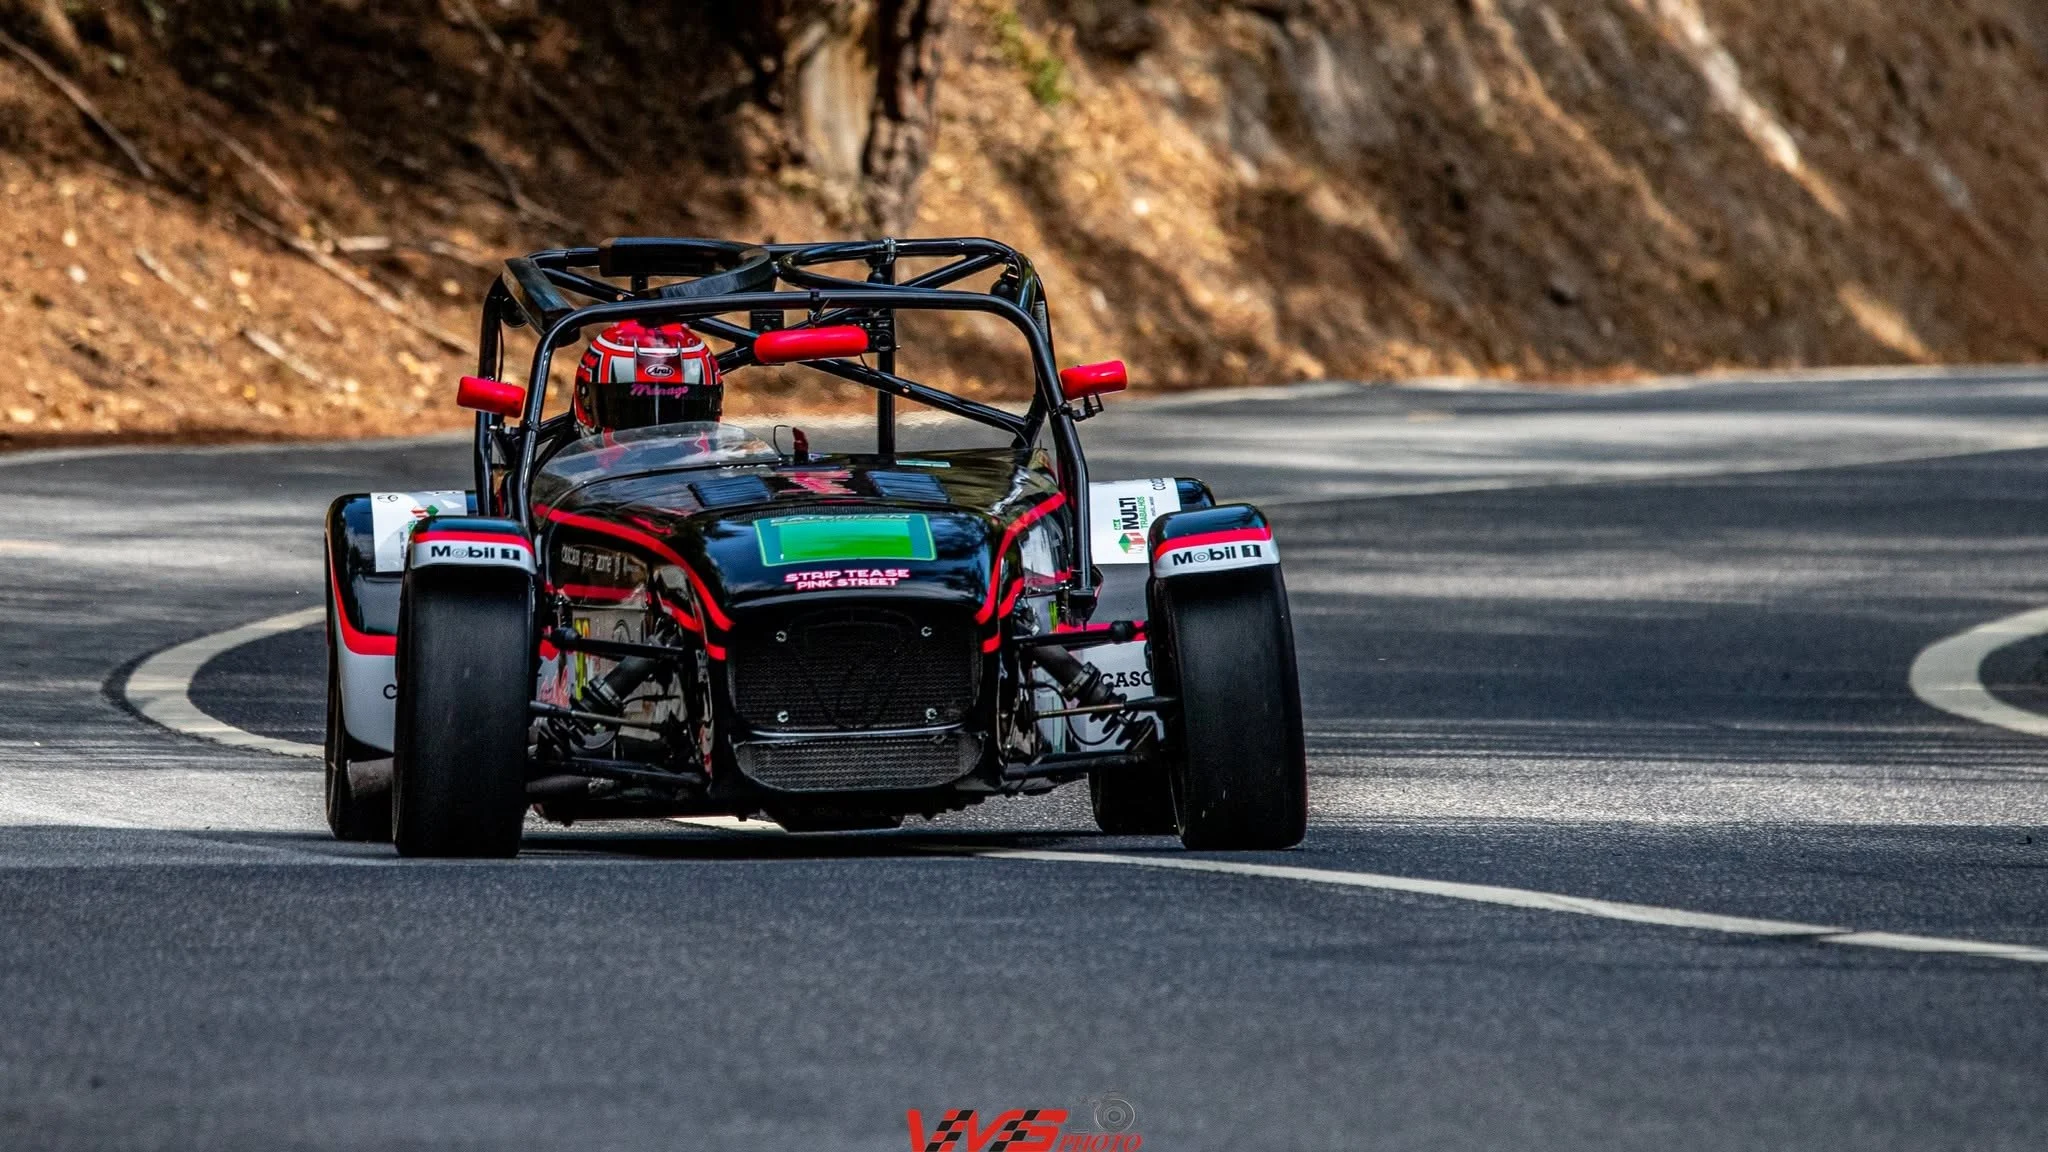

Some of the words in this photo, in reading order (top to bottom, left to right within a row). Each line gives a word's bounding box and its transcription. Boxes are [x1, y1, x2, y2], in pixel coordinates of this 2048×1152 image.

[649, 366, 671, 374] Arai
[1118, 497, 1140, 530] MULTI
[430, 545, 495, 559] Mobil
[501, 548, 521, 561] 1
[1171, 546, 1237, 566] Mobil
[1241, 544, 1262, 558] 1
[785, 570, 841, 583] STRIP
[844, 568, 910, 578] TEASE
[796, 580, 833, 590] PINK
[837, 577, 899, 587] STREET
